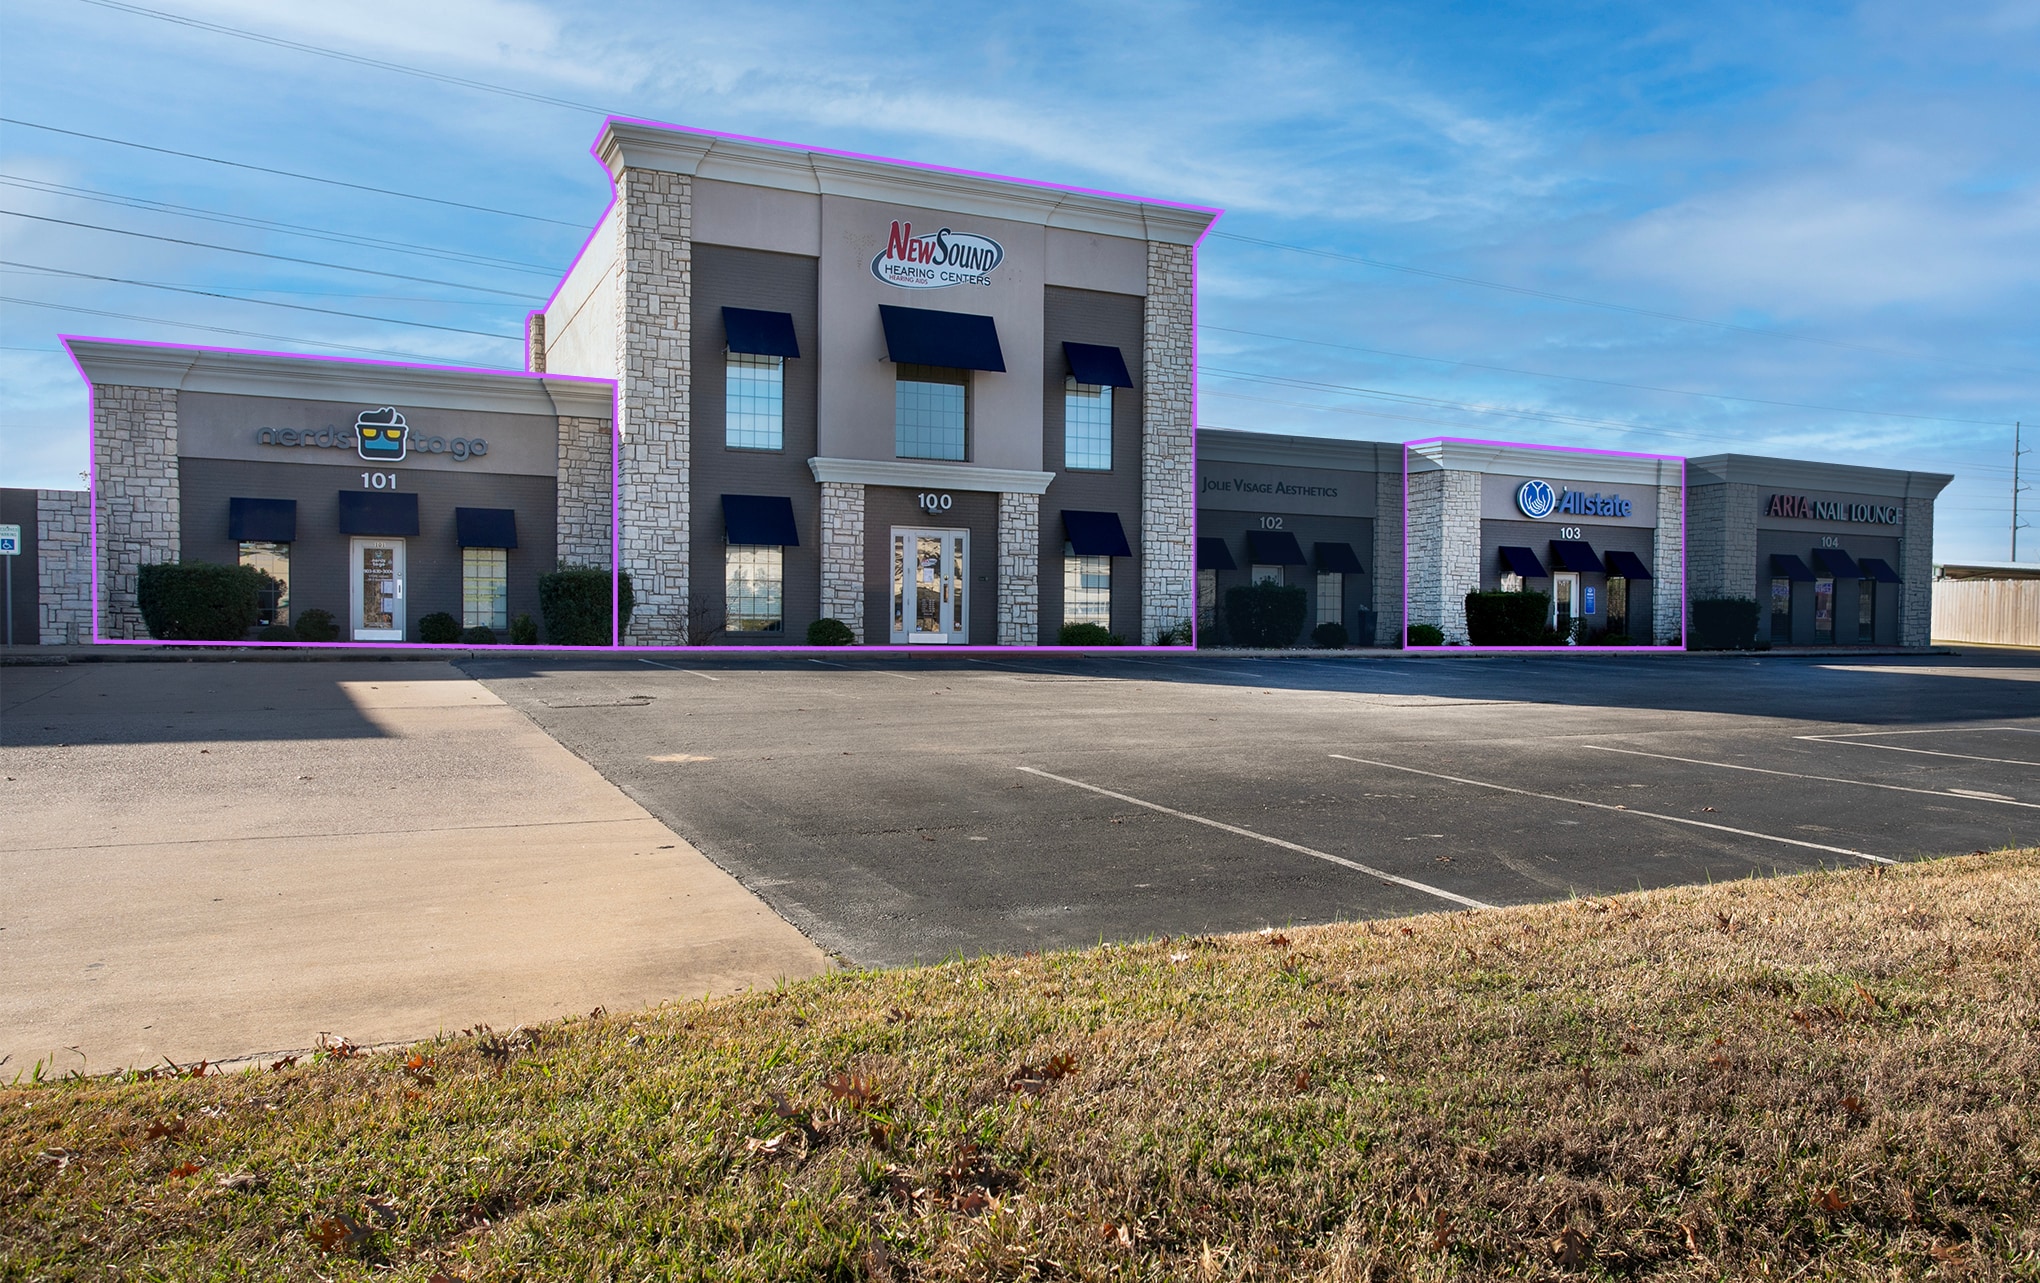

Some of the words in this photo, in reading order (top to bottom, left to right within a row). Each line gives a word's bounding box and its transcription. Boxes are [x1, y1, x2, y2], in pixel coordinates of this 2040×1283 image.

[885, 264, 935, 279] HEARING
[940, 271, 991, 286] CENTERS
[889, 275, 914, 283] HEARING
[257, 424, 351, 449] nerds
[361, 472, 397, 489] 101
[918, 493, 952, 510] 100
[1558, 490, 1632, 517] Allstate
[1768, 494, 1811, 518] ARIA
[1814, 501, 1846, 520] NAIL
[1849, 503, 1904, 525] LOUNGE
[1260, 517, 1283, 529] 102
[1561, 527, 1581, 539] 103
[1822, 536, 1839, 548] 104
